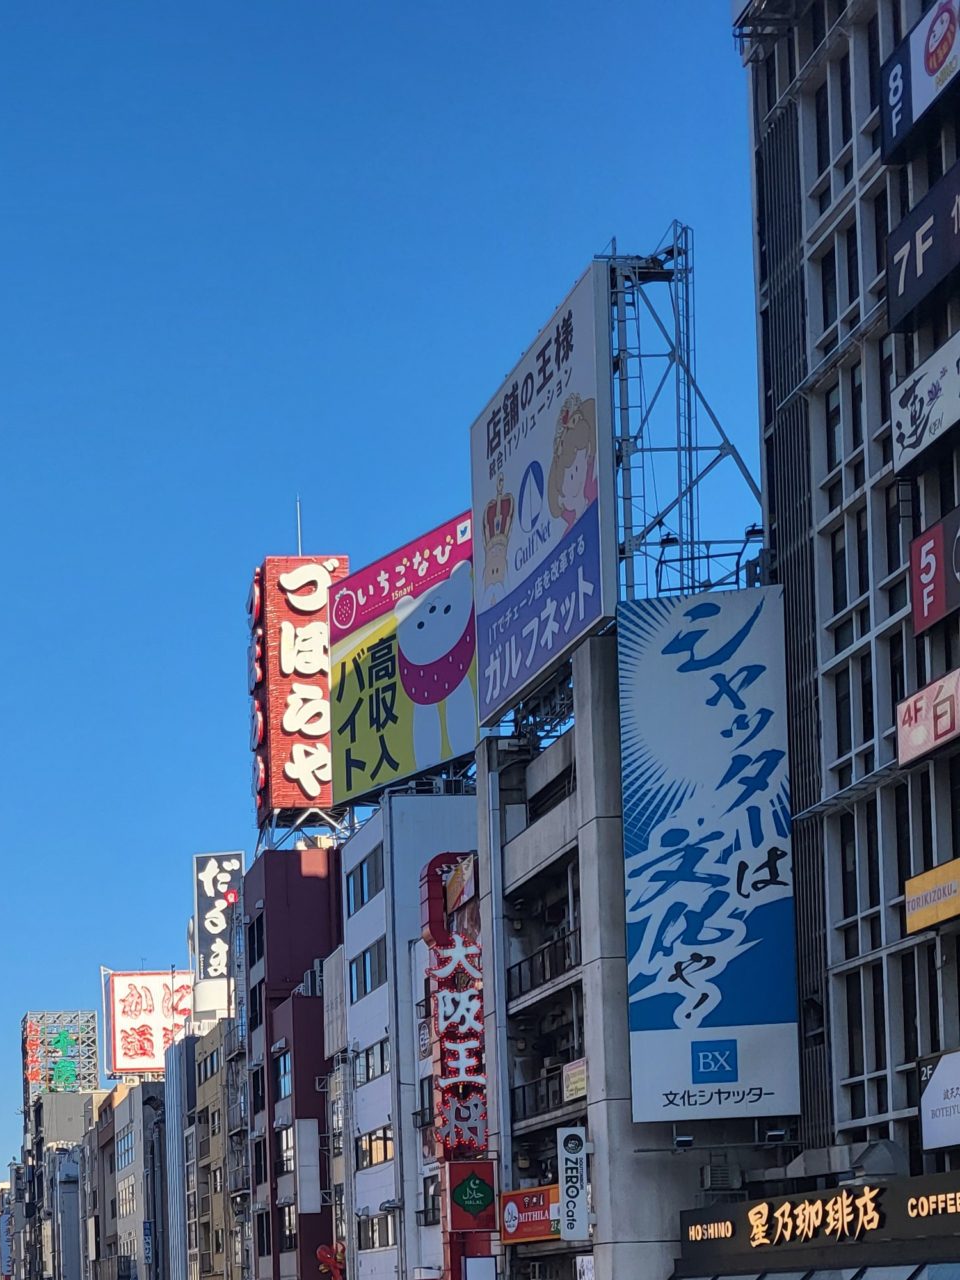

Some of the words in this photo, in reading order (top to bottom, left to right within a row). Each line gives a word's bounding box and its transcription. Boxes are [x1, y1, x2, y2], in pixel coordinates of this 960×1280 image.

[888, 62, 904, 139] 8F
[893, 215, 934, 297] 7F
[485, 309, 575, 461] 店舗の王様
[356, 534, 454, 608] いちごなび
[919, 538, 937, 618] 5F
[484, 562, 595, 707] ガルフネット
[336, 646, 368, 792] バイト
[367, 633, 400, 781] 高収入
[901, 693, 924, 728] 4F
[906, 886, 954, 913] TORIKIZOKU
[430, 932, 487, 1146] 大阪王将
[698, 1051, 732, 1074] BX
[920, 1066, 932, 1081] 2F
[518, 1209, 550, 1222] MITHILA
[689, 1220, 732, 1241] HOSHINO
[747, 1185, 880, 1248] 星乃珈琲店
[907, 1192, 960, 1217] COFFEE
